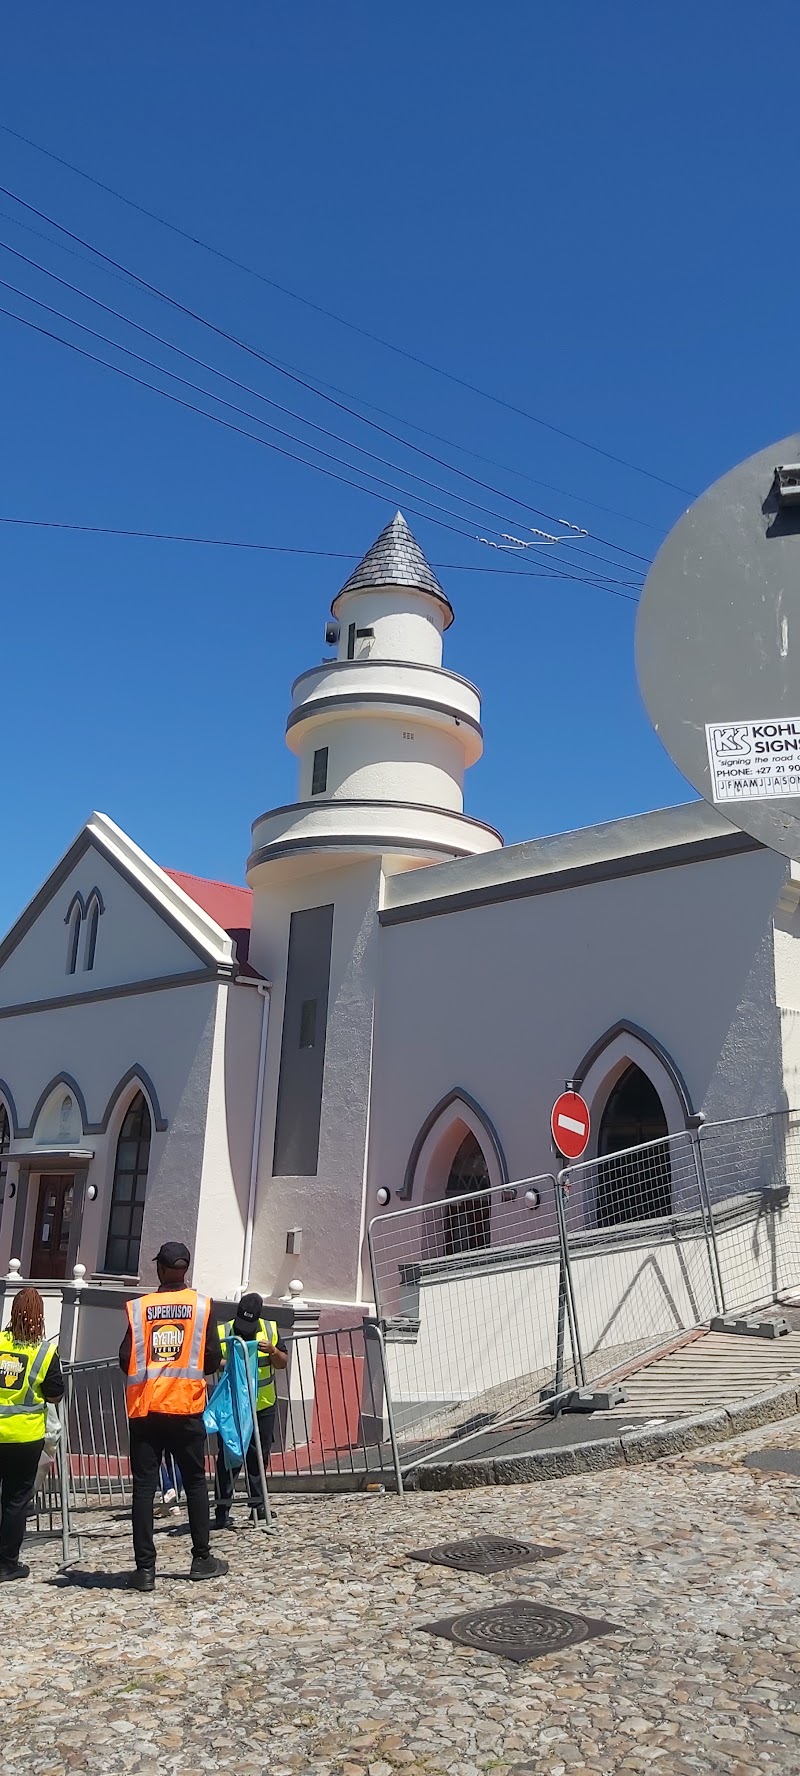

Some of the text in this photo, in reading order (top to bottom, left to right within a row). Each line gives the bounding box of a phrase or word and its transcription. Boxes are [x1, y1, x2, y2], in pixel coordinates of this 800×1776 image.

[754, 739, 800, 753] SIGN
[772, 754, 793, 762] road
[716, 768, 753, 777] PHONE:
[756, 766, 771, 774] +27
[775, 765, 785, 773] 21
[147, 1305, 193, 1320] SUPERVISOR
[152, 1330, 184, 1347] EYETHU
